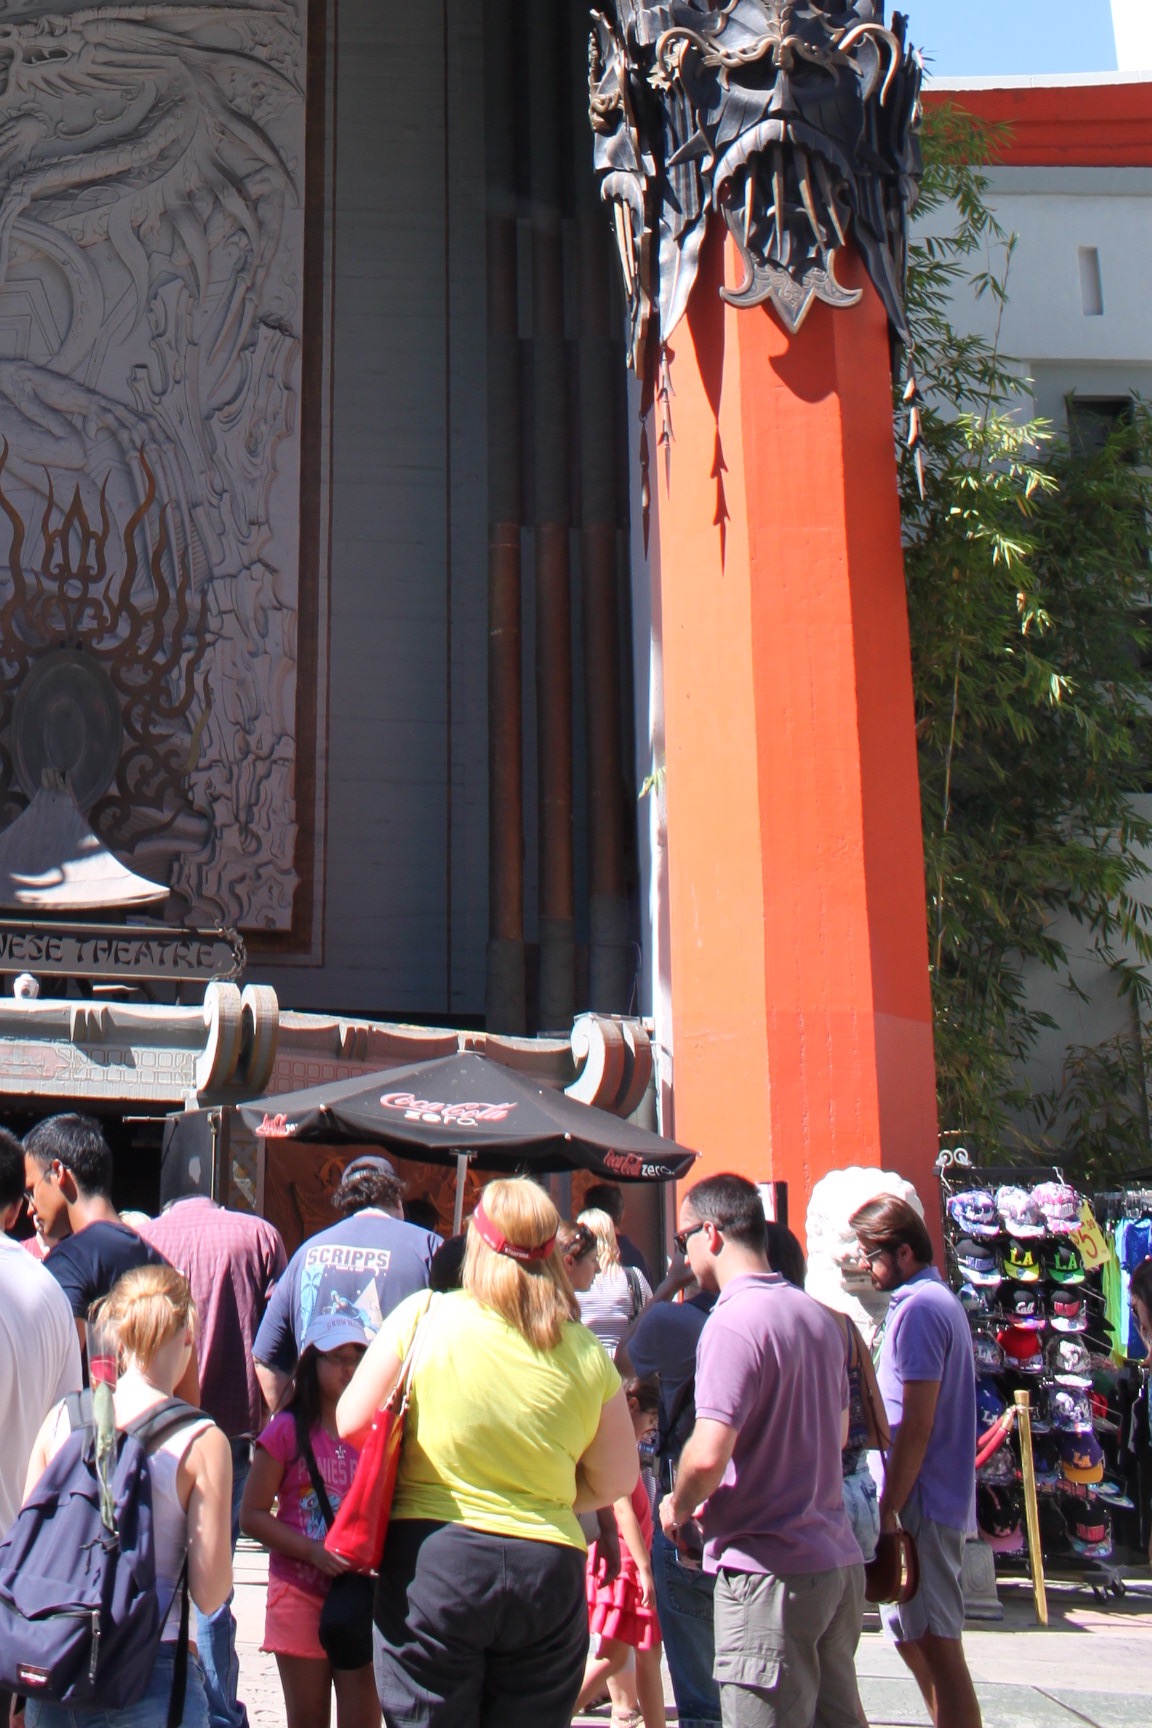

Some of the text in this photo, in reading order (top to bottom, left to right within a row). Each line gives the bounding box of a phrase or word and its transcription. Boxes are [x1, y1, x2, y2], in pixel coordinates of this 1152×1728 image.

[75, 937, 214, 969] THEATRE
[379, 1092, 518, 1121] Coca-Cola
[307, 1247, 389, 1268] SCRIPPS
[1010, 1247, 1034, 1266] LA
[1055, 1251, 1078, 1270] LA
[298, 1456, 347, 1485] PNIES
